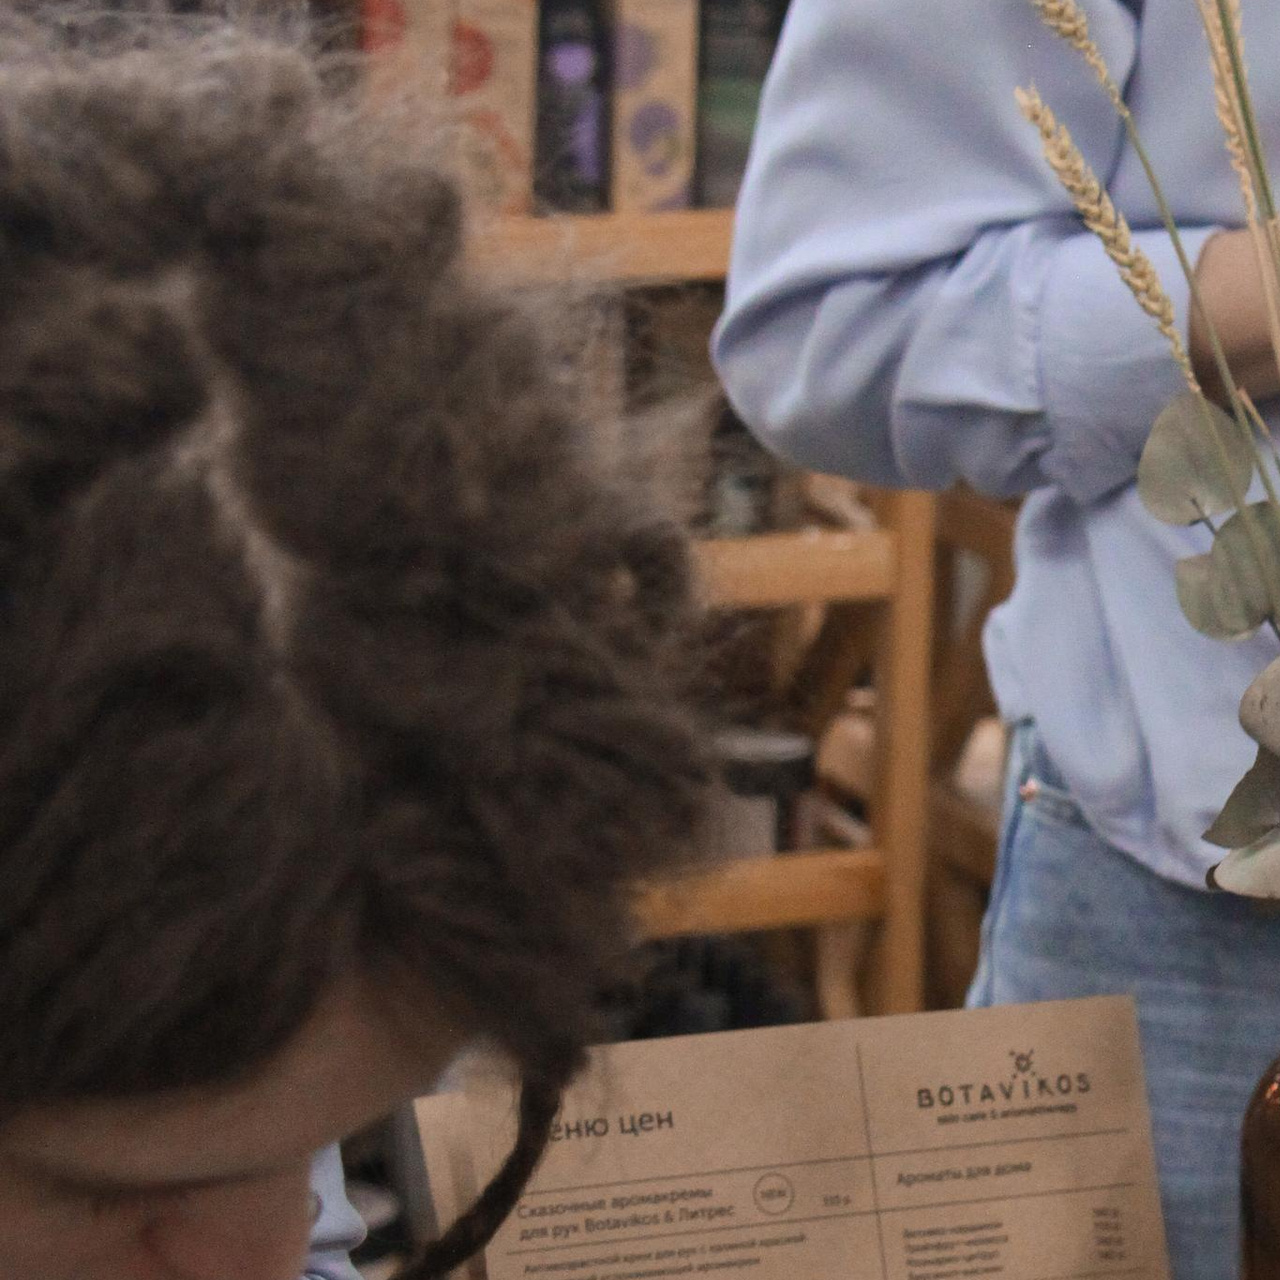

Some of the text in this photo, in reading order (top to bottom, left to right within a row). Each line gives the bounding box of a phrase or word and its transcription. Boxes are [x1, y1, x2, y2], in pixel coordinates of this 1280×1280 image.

[915, 1070, 1092, 1111] BOTAVIKOS
[546, 1108, 675, 1143] еню цен
[516, 1195, 607, 1221] Сказочные
[518, 1224, 546, 1241] для
[551, 1220, 581, 1239] рук
[583, 1210, 660, 1233] Botavikos
